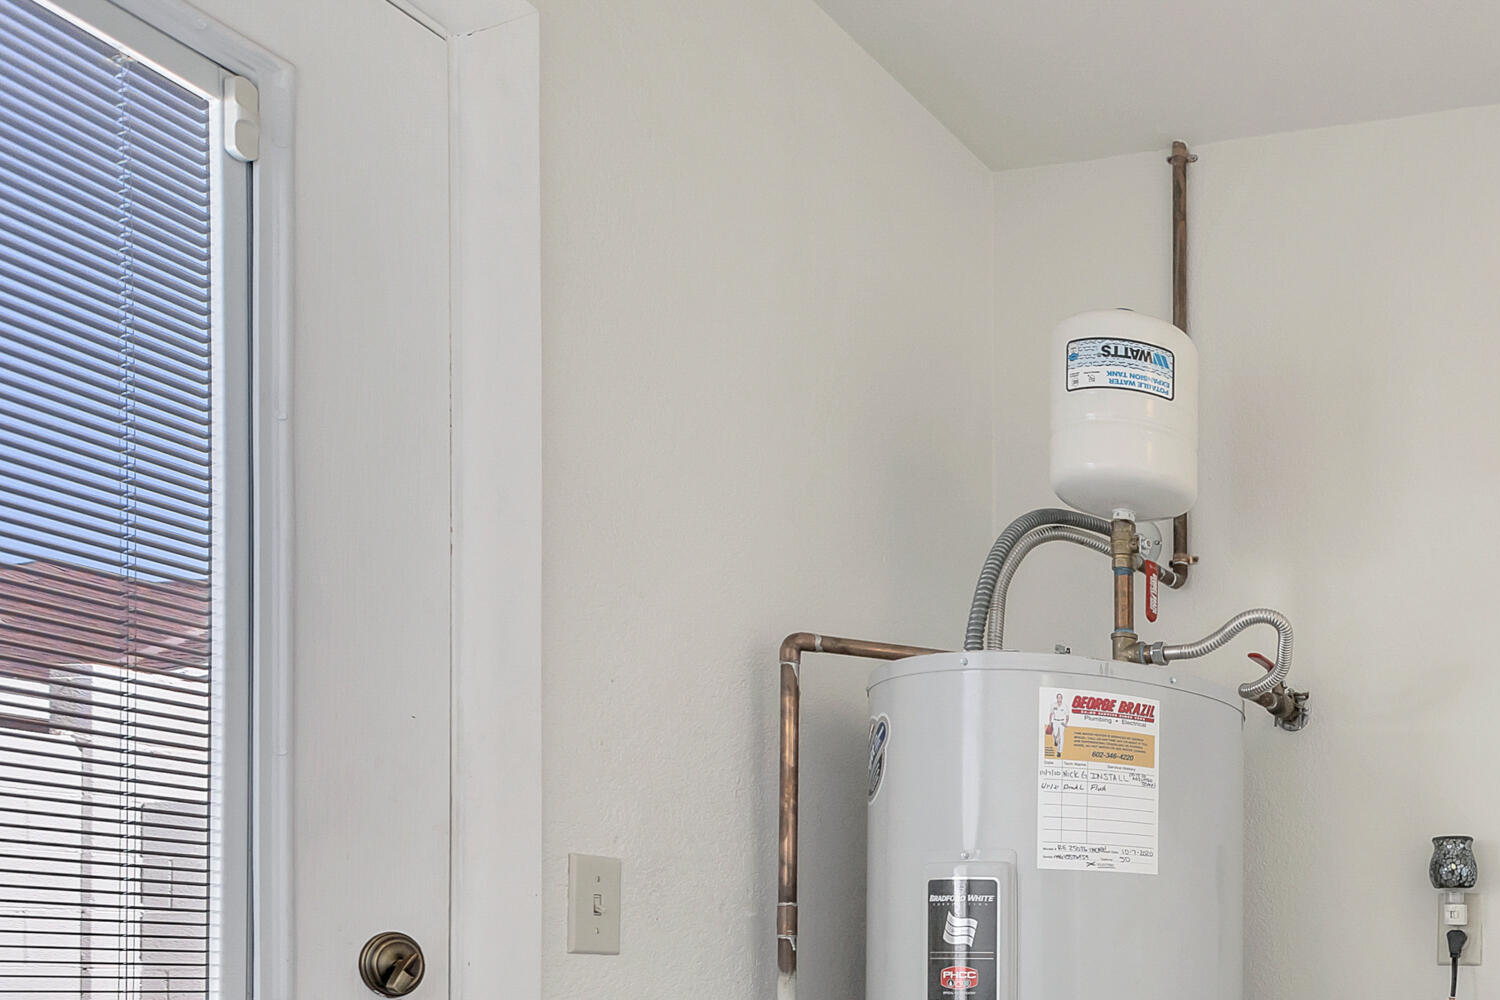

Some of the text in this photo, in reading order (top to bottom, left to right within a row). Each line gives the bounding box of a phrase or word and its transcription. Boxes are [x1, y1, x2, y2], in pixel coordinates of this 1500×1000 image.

[1101, 344, 1153, 364] WATTS
[1106, 370, 1128, 378] TANK
[1108, 378, 1136, 387] WATER
[1072, 695, 1156, 718] GEORGE BRAZIL
[1083, 715, 1112, 724] Plumbing
[1121, 719, 1147, 728] Electrical
[1089, 772, 1129, 783] INSTALL
[929, 894, 995, 902] BRADFOD WHITE
[943, 971, 977, 979] PHCC
